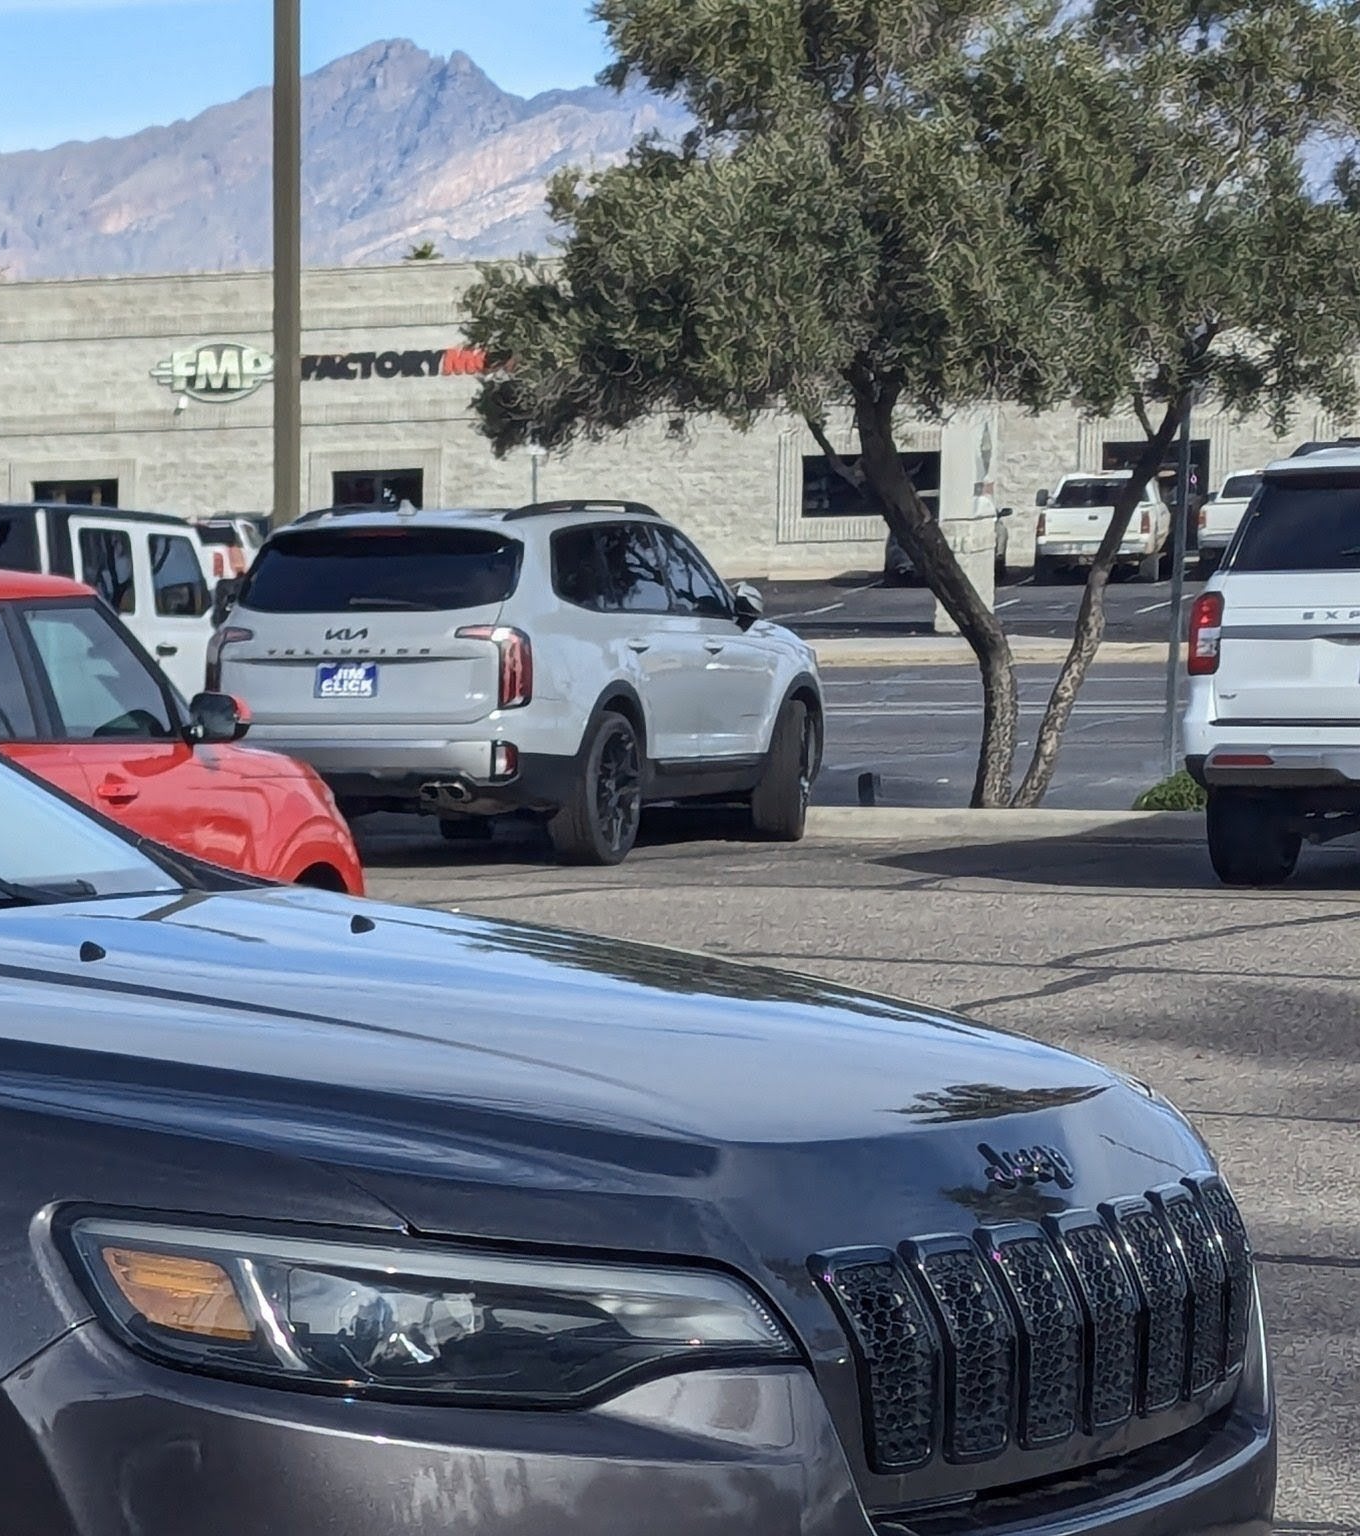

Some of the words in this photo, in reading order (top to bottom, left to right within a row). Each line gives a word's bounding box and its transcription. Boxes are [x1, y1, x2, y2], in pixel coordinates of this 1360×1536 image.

[171, 349, 274, 392] FMP
[324, 627, 369, 641] KIA
[333, 668, 366, 680] JIM
[321, 679, 373, 692] CLICK
[976, 1142, 1076, 1190] Jeep
